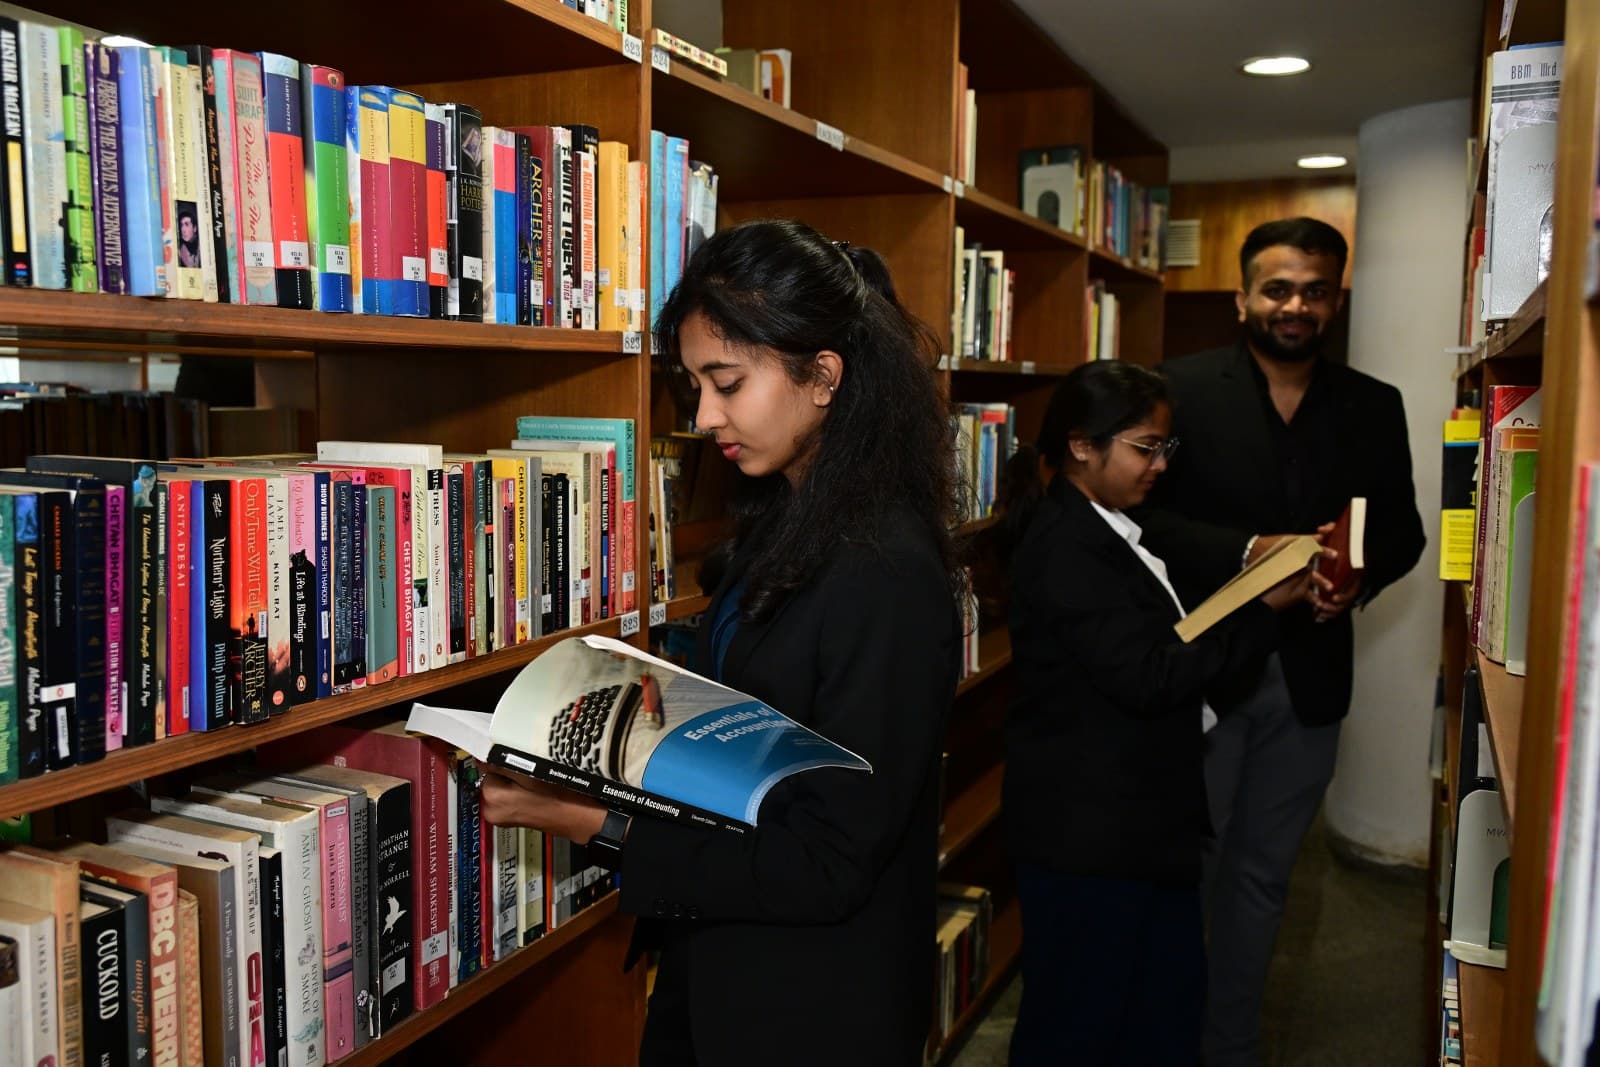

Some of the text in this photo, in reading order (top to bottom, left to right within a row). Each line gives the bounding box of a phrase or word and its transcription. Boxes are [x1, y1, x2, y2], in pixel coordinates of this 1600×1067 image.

[0, 30, 18, 82] ALISTAIR
[72, 47, 84, 83] NICK
[624, 39, 641, 57] 823
[1511, 64, 1532, 80] BBM
[73, 92, 88, 153] HORNBY
[100, 125, 115, 149] THE
[77, 157, 91, 196] HIGH
[460, 197, 482, 208] POTTE
[531, 162, 543, 242] ARCHER
[562, 160, 573, 213] WHITE
[103, 194, 122, 267] ALTERNATIVE
[583, 223, 594, 273] APPRENTICE
[158, 492, 166, 523] SOCIALITE
[320, 483, 328, 507] SHOW
[432, 469, 441, 527] MISTRESS
[601, 474, 609, 502] ALISTAIR
[110, 494, 120, 549] CHETAN
[158, 524, 166, 555] EVENINGS
[176, 493, 186, 588] ANITA DESAI
[244, 482, 262, 609] Only Time Will Tell
[267, 484, 276, 557] CLAVELL'S
[276, 498, 284, 541] JAMES
[320, 508, 328, 542] BUSINESS
[626, 504, 634, 572] VIKAS SWAR
[110, 551, 120, 605] BHAGAT
[210, 538, 227, 620] Northern Lights
[320, 546, 328, 572] SHASHI
[402, 540, 412, 586] CHETAN
[433, 543, 442, 567] Anita
[272, 562, 281, 621] KING RAT
[293, 571, 306, 643] Life at Blandings
[403, 588, 413, 634] BHAGAT
[211, 642, 226, 718] Philip Pullman
[243, 639, 256, 700] ARCHER
[253, 642, 265, 689] JEFFREY
[684, 710, 760, 741] Essentials
[571, 775, 591, 788] Anthony
[602, 784, 680, 818] Essentials of Accounting
[429, 822, 438, 874] WILLIAM
[246, 850, 256, 936] VIKAS SWARUP
[300, 834, 313, 932] AMITAV GHOSH
[328, 844, 337, 910] hari kunzru
[337, 842, 347, 923] IMPRESSIONIST
[472, 803, 481, 949] DOUGLAS ADAMS
[150, 881, 176, 957] DBC
[429, 875, 439, 936] SHAKESPE
[97, 929, 120, 1020] CUCKOLD
[130, 959, 148, 1034] immigrant
[301, 973, 311, 1016] SMOKE
[311, 963, 320, 997] RIVER
